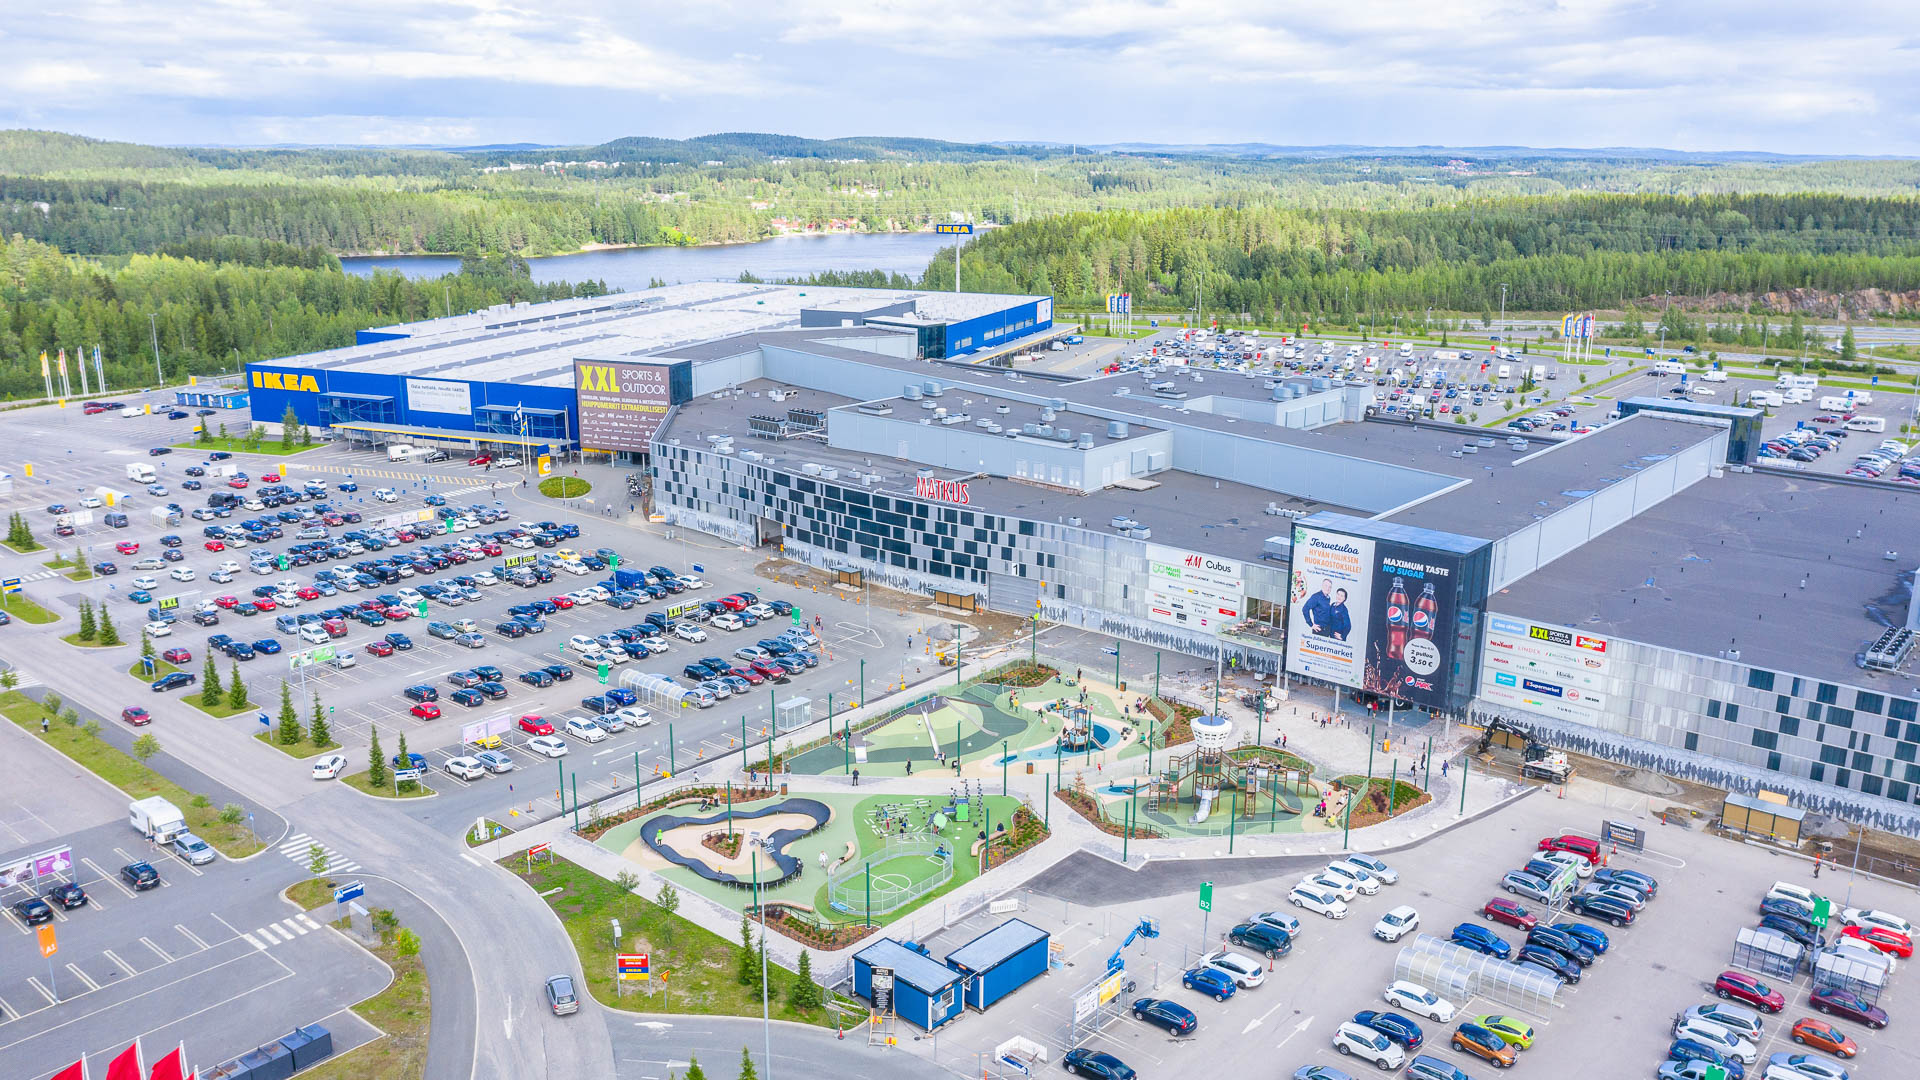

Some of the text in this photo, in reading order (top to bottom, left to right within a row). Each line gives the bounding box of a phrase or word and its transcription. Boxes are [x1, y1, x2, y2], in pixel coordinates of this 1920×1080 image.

[938, 225, 969, 233] IKEA
[252, 371, 320, 393] IKEA
[580, 365, 620, 393] XXL
[622, 369, 662, 382] SPORTS &
[622, 382, 666, 395] OUTDOOR
[916, 475, 969, 505] MATKUS
[1310, 537, 1359, 555] Tervetuloa
[506, 557, 520, 568] XXL
[1206, 560, 1232, 573] Cubus
[1383, 557, 1450, 576] MAXIMUM TASTE
[1012, 564, 1018, 576] 1
[1382, 564, 1425, 579] NO SUGAR
[160, 598, 178, 609] XXL
[668, 606, 682, 618] XXL
[1531, 626, 1549, 640] XXL
[1306, 640, 1353, 659] Supermarket
[1409, 655, 1427, 666] 3,50
[1200, 899, 1210, 910] B2
[1813, 915, 1826, 926] A1
[46, 943, 57, 955] A1
